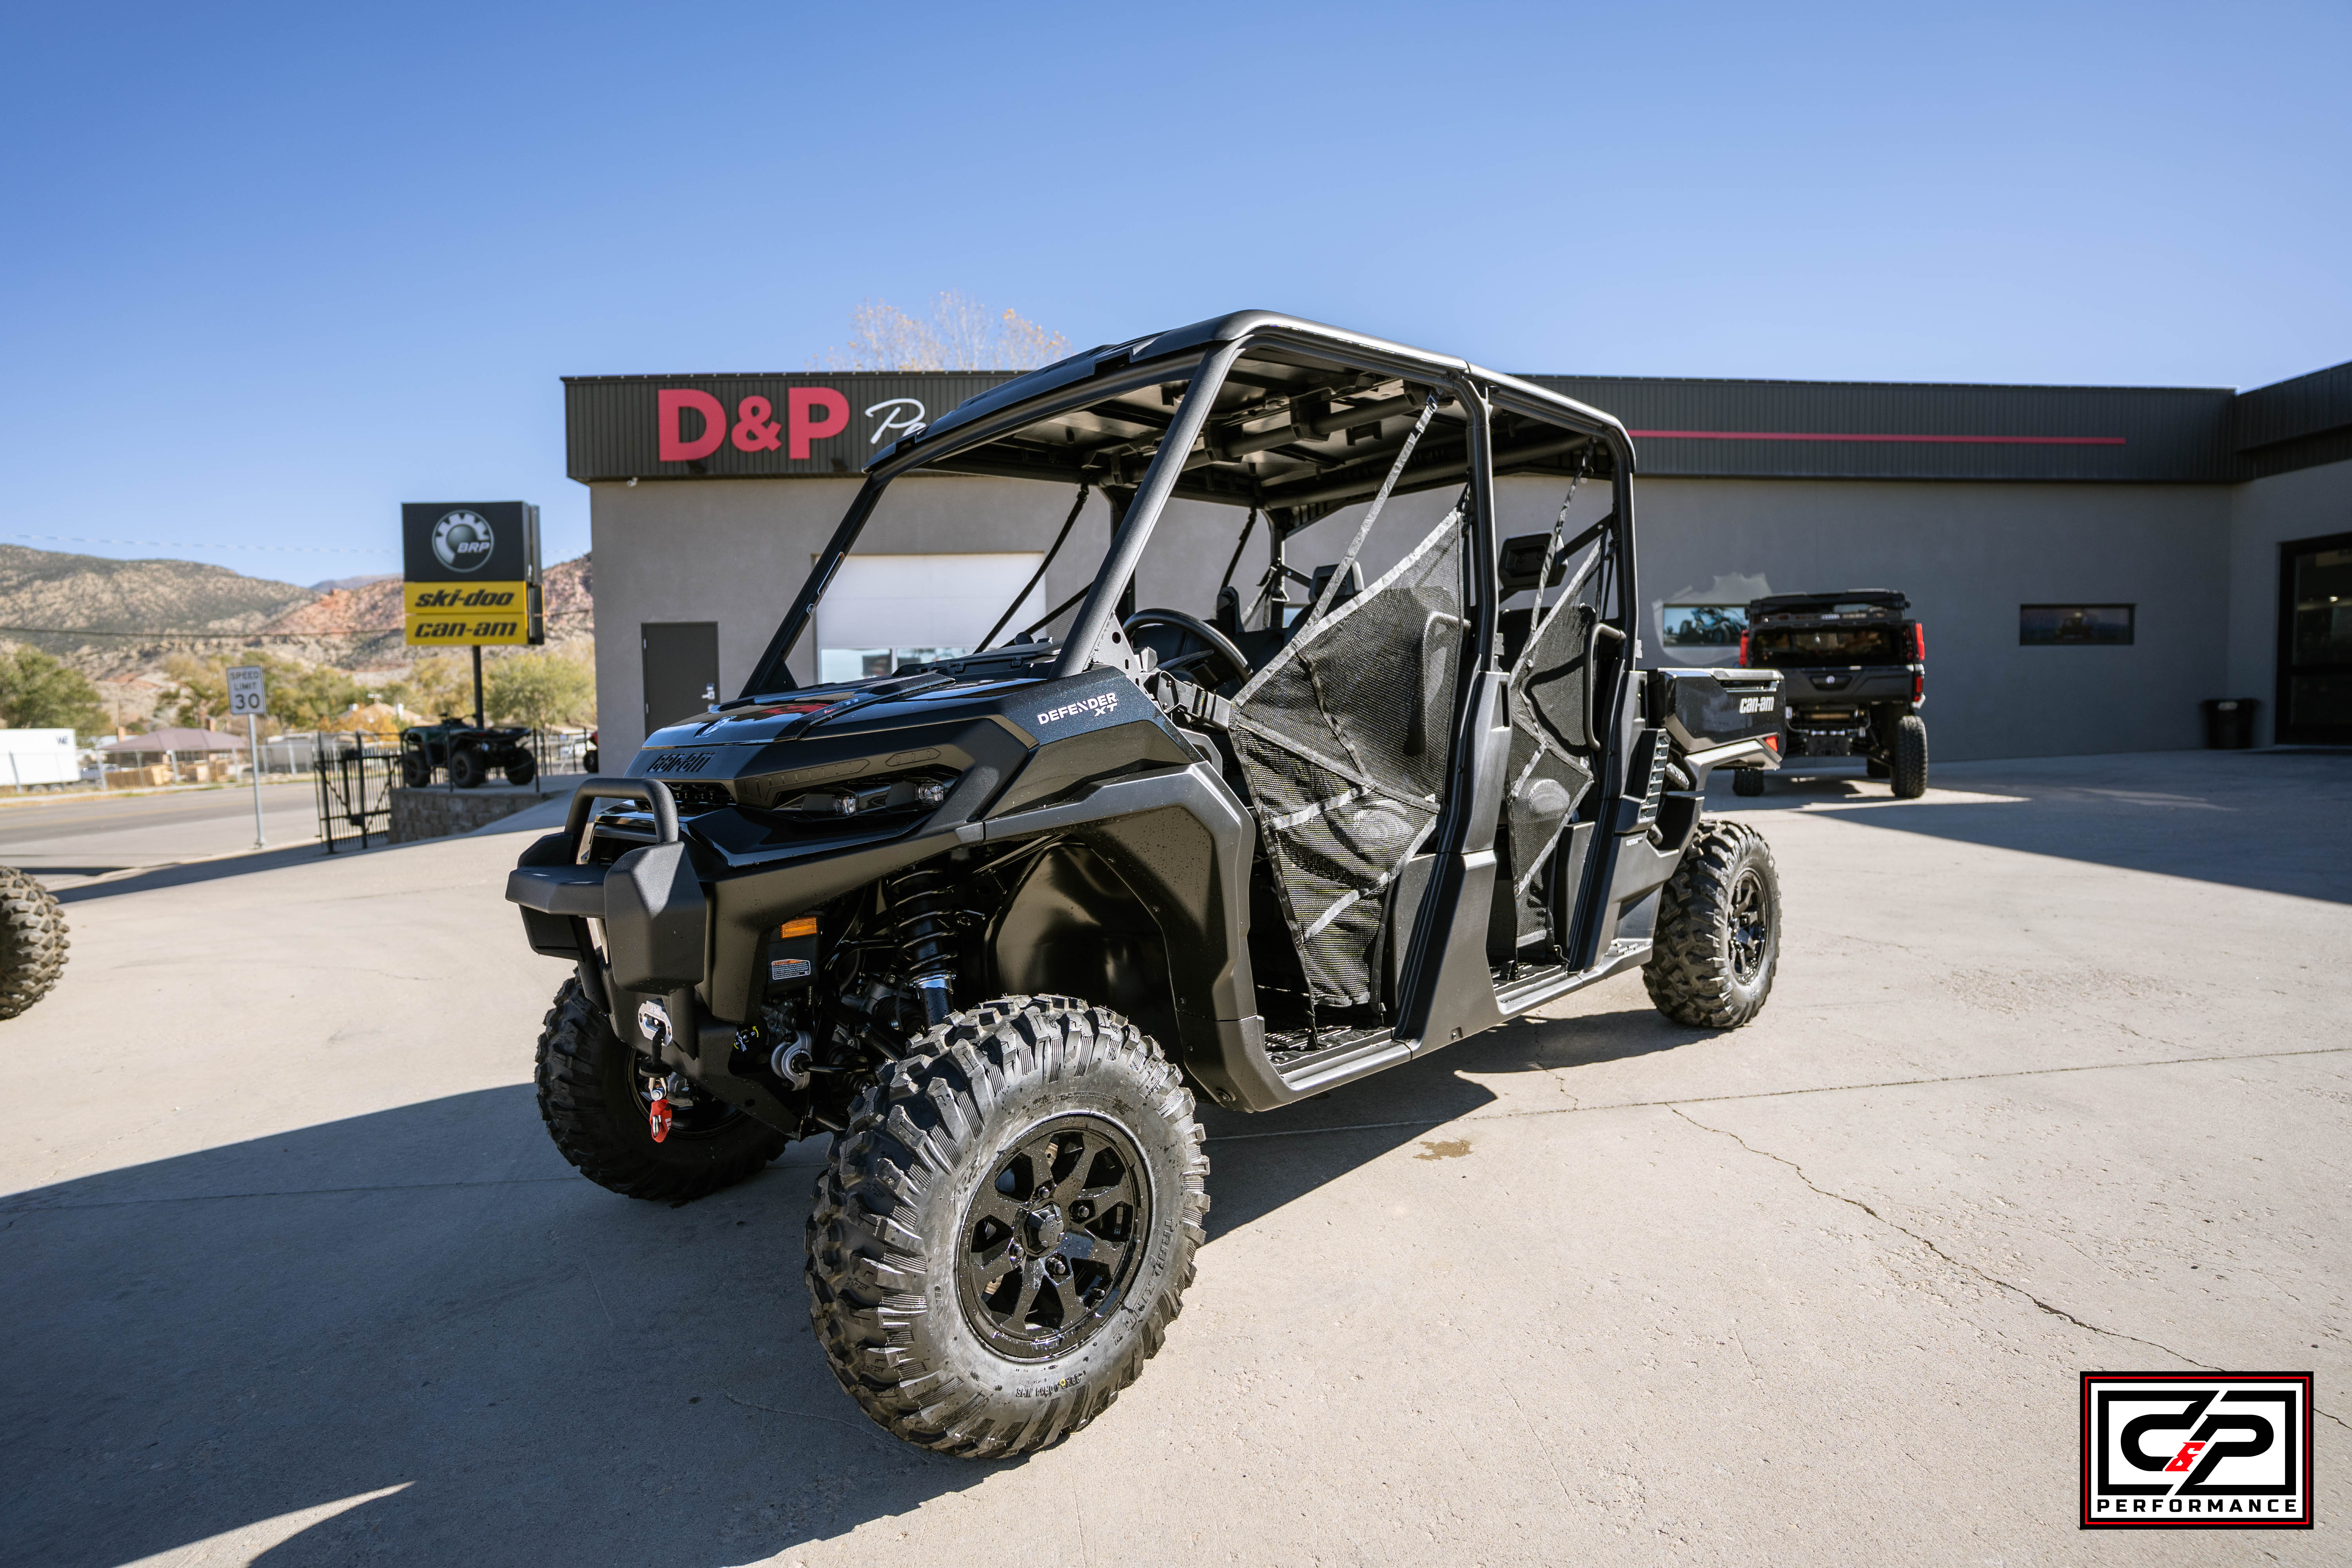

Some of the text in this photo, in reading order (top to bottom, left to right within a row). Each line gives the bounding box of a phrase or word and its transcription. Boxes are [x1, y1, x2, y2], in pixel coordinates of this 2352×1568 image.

[659, 387, 850, 462] D&P
[457, 541, 490, 554] BRP
[414, 588, 515, 607] ski-doo
[414, 622, 517, 638] can-am
[230, 671, 259, 680] SPEED
[234, 682, 257, 690] LIMIT
[235, 693, 260, 710] 30
[1037, 692, 1119, 725] DEFENDER
[1094, 702, 1118, 717] XT
[1739, 696, 1775, 714] can-am
[1124, 1279, 1156, 1332] KING
